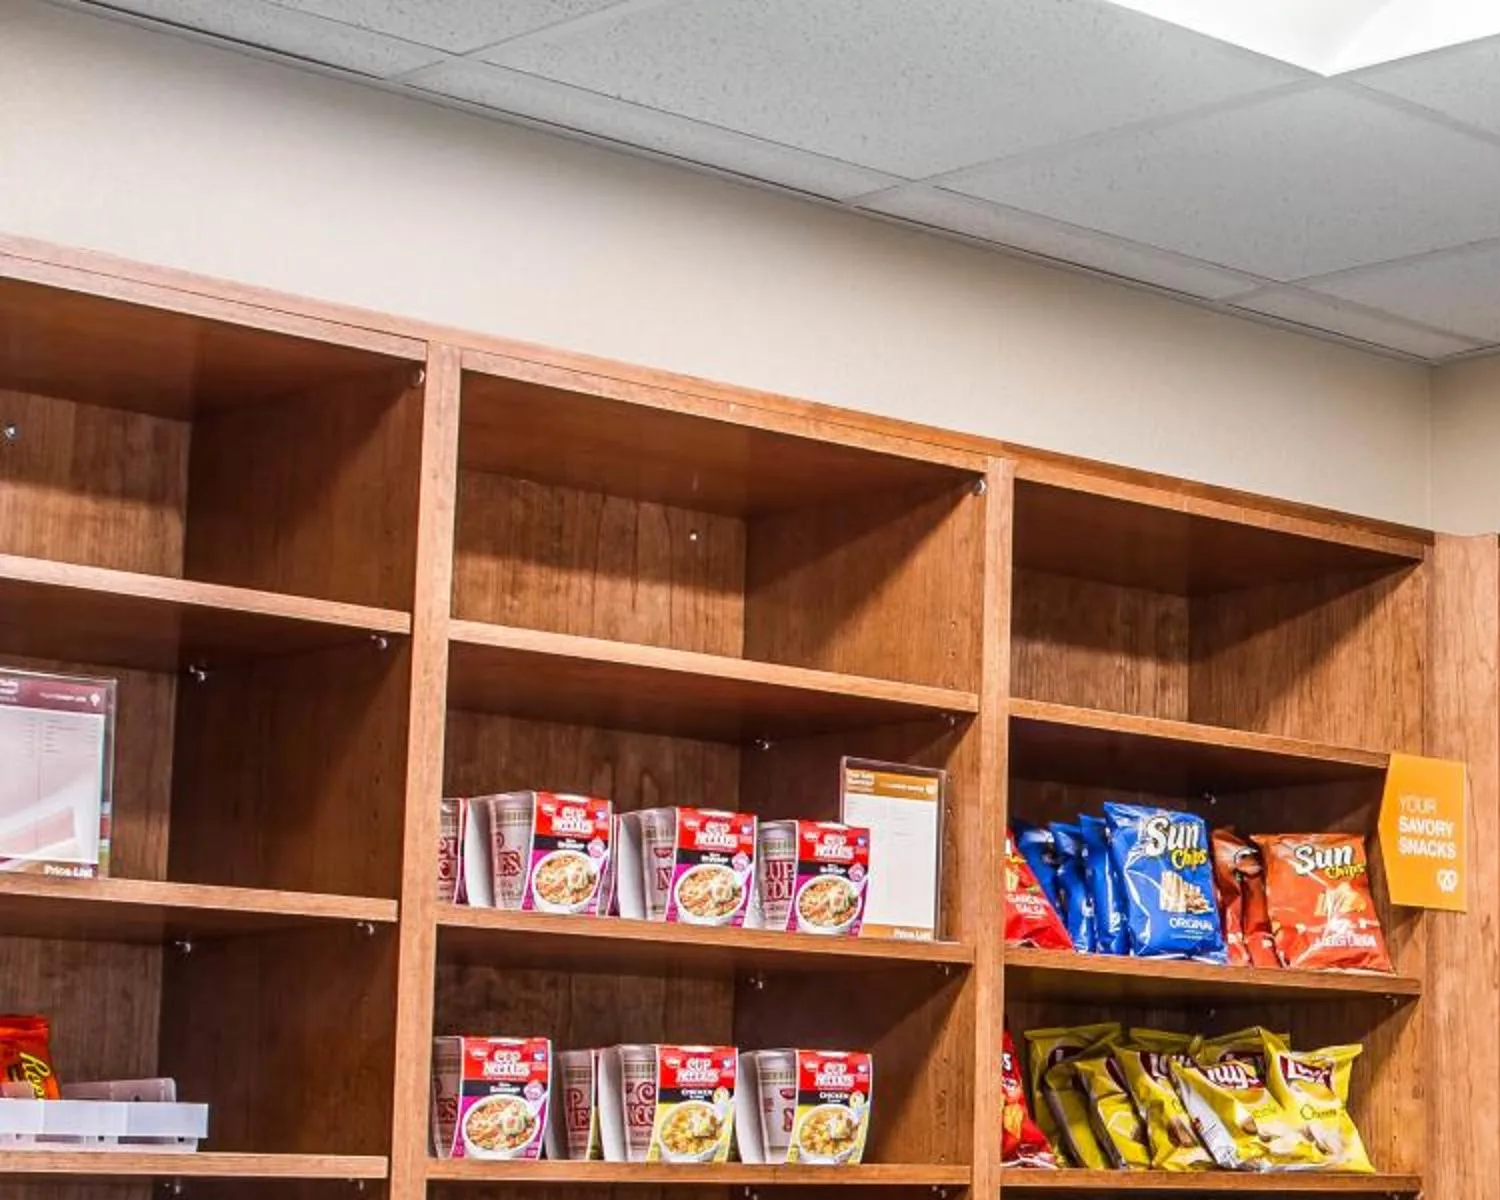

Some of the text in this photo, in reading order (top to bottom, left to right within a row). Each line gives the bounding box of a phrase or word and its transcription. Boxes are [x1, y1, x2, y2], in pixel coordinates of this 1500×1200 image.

[1400, 795, 1437, 813] YOUR
[1146, 815, 1200, 857] Sun
[1398, 815, 1455, 837] SAVORY
[1171, 848, 1208, 869] Chips
[1398, 837, 1457, 859] SNACKS
[1295, 843, 1354, 876] Sun
[1325, 863, 1367, 880] Chips
